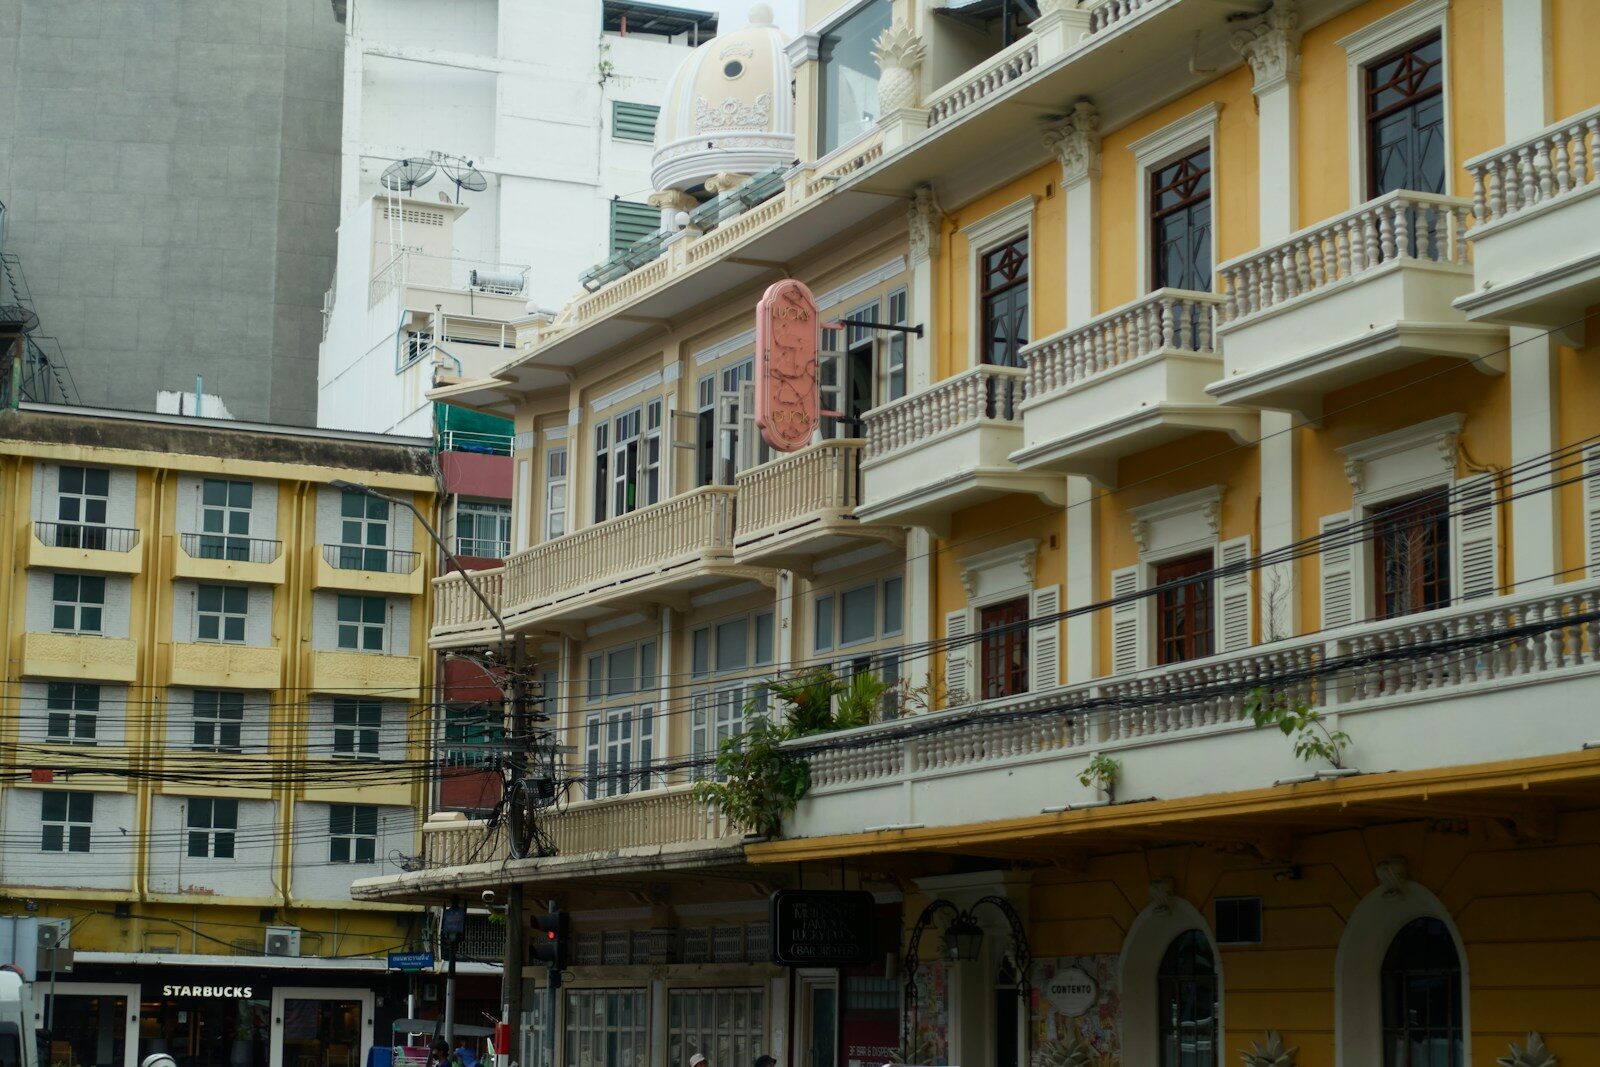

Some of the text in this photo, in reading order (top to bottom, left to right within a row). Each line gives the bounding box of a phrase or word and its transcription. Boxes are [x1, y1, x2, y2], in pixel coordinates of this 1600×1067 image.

[772, 305, 810, 321] LUCKY
[774, 409, 809, 424] DUCK
[162, 985, 253, 998] STARBUCKS
[1051, 985, 1092, 994] CONTENTO
[856, 1046, 867, 1056] BAR
